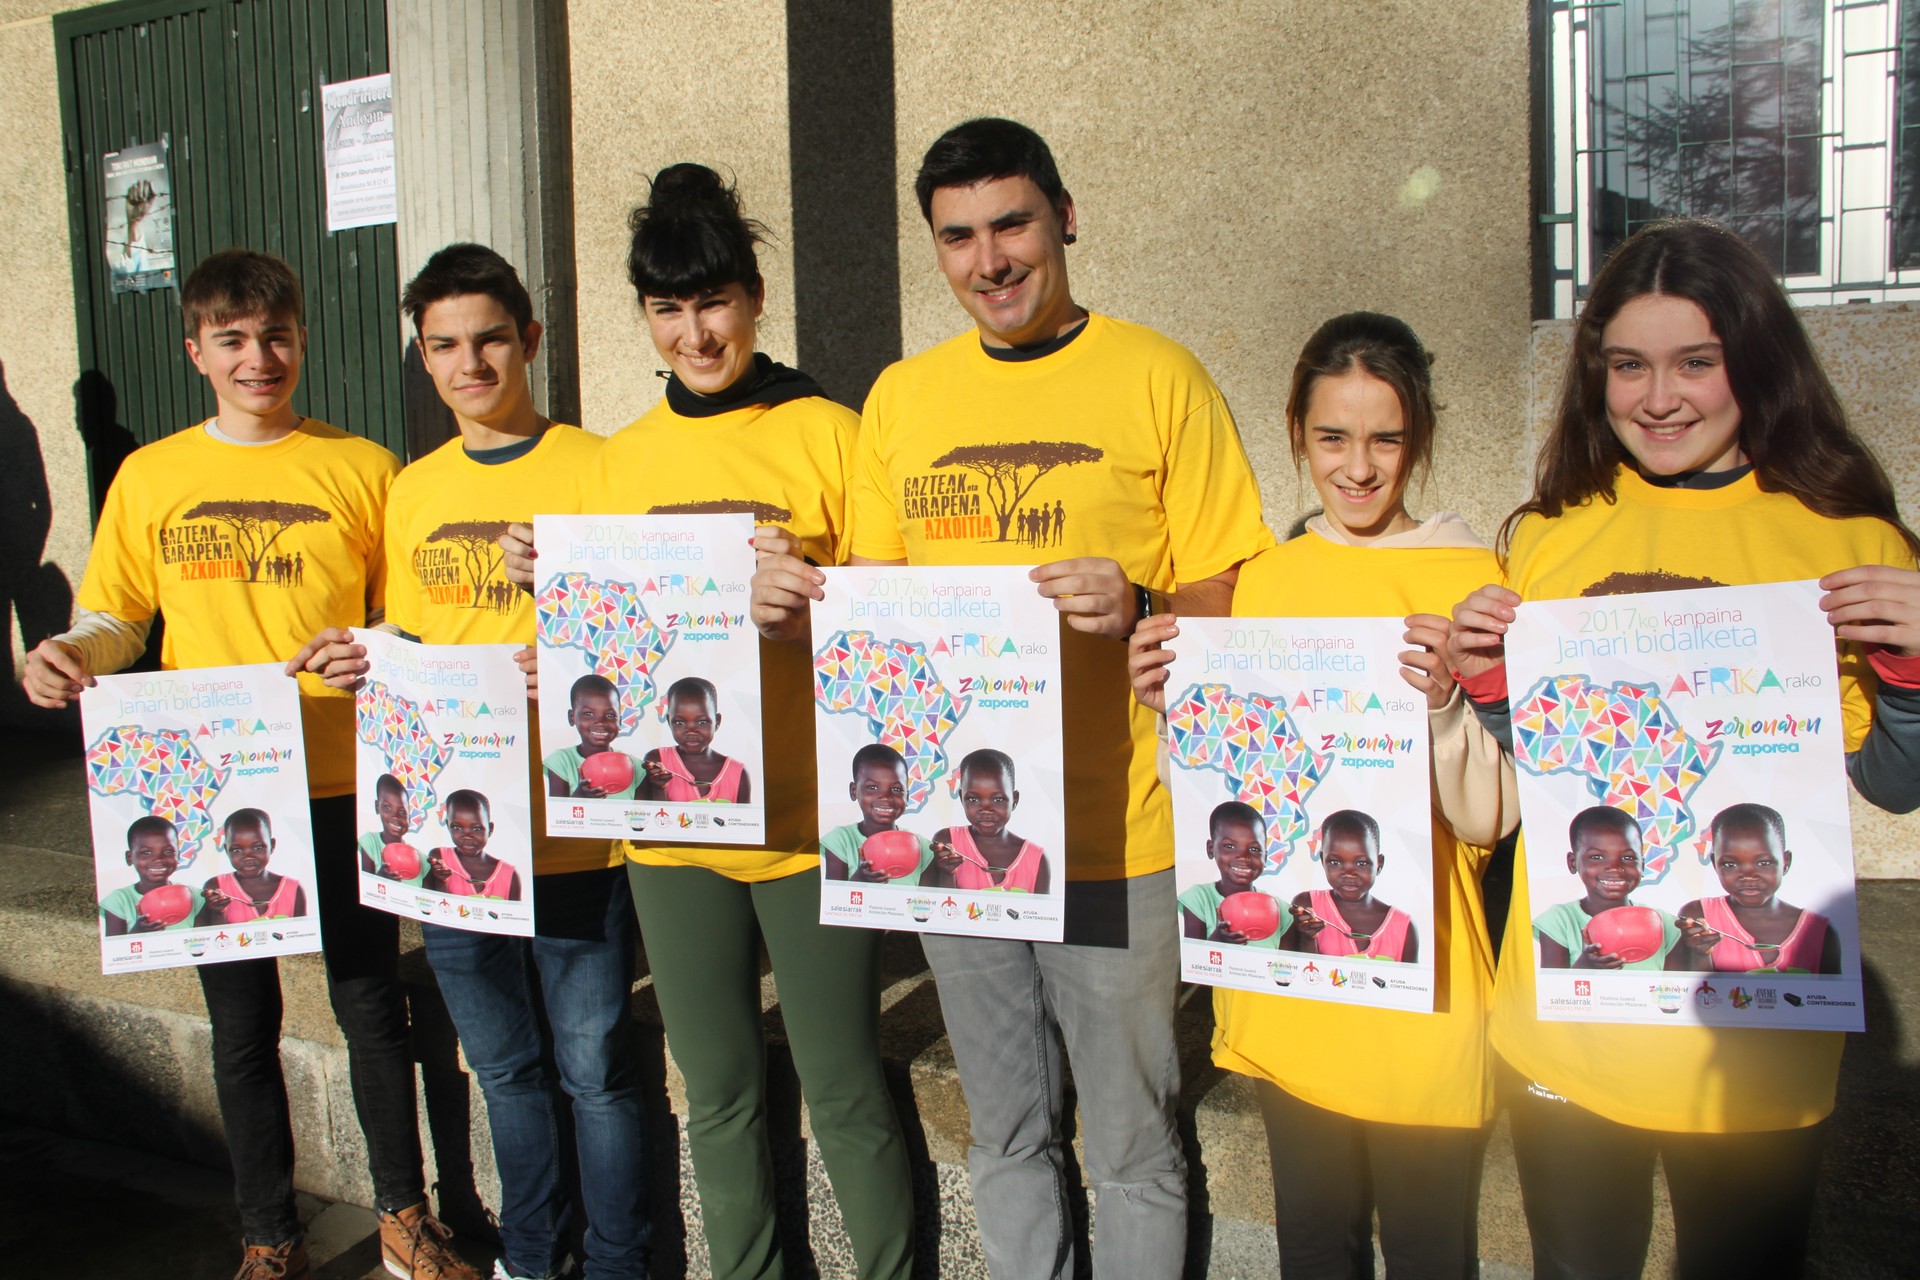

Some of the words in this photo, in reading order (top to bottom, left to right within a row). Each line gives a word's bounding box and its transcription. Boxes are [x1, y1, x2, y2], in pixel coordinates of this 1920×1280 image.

[336, 108, 385, 129] Andoain
[904, 473, 968, 498] GAZTEAK
[967, 483, 979, 493] eta
[904, 493, 981, 520] GARAPENA
[159, 523, 219, 547] GAZTEAK
[584, 524, 638, 542] 2017ko
[642, 529, 695, 545] kanpaina
[924, 514, 994, 541] AZKOITIA
[162, 541, 234, 565] GARAPENA
[415, 546, 452, 568] AZTEAK
[568, 541, 617, 563] Janari
[622, 538, 703, 561] bidalketa
[180, 559, 246, 581] AZKOITIA
[417, 565, 460, 587] ARAPENA
[866, 577, 928, 597] 2017ko
[932, 583, 991, 600] kanpaina
[848, 597, 904, 621] Janari
[910, 595, 1001, 618] bidalketa
[1577, 607, 1659, 633] 2017ko
[1664, 607, 1742, 631] kanpaina
[683, 633, 729, 643] zaporea
[1223, 629, 1287, 649] 2017ko
[1291, 634, 1354, 654] kanpaina
[1555, 630, 1628, 664] Janari
[1635, 625, 1758, 653] bidalketa
[420, 657, 470, 672] kanpaina
[1203, 649, 1261, 673] Janari
[1268, 647, 1366, 672] bidalketa
[376, 656, 404, 677] Janari
[407, 666, 478, 687] bidalketa
[133, 679, 190, 698] 2017ko
[192, 678, 244, 695] kanpaina
[118, 695, 169, 719] Janari
[172, 691, 252, 711] bidalketa
[978, 698, 1029, 710] zaporea
[458, 750, 500, 760] zaporea
[1732, 741, 1799, 757] zaporea
[236, 765, 279, 779] zaporea
[1341, 756, 1395, 769] zaporea
[831, 904, 863, 913] salesiarrak
[1191, 964, 1223, 973] salesiarrak
[1390, 984, 1428, 992] CONTENEDORES
[1550, 997, 1591, 1006] salesiarrak
